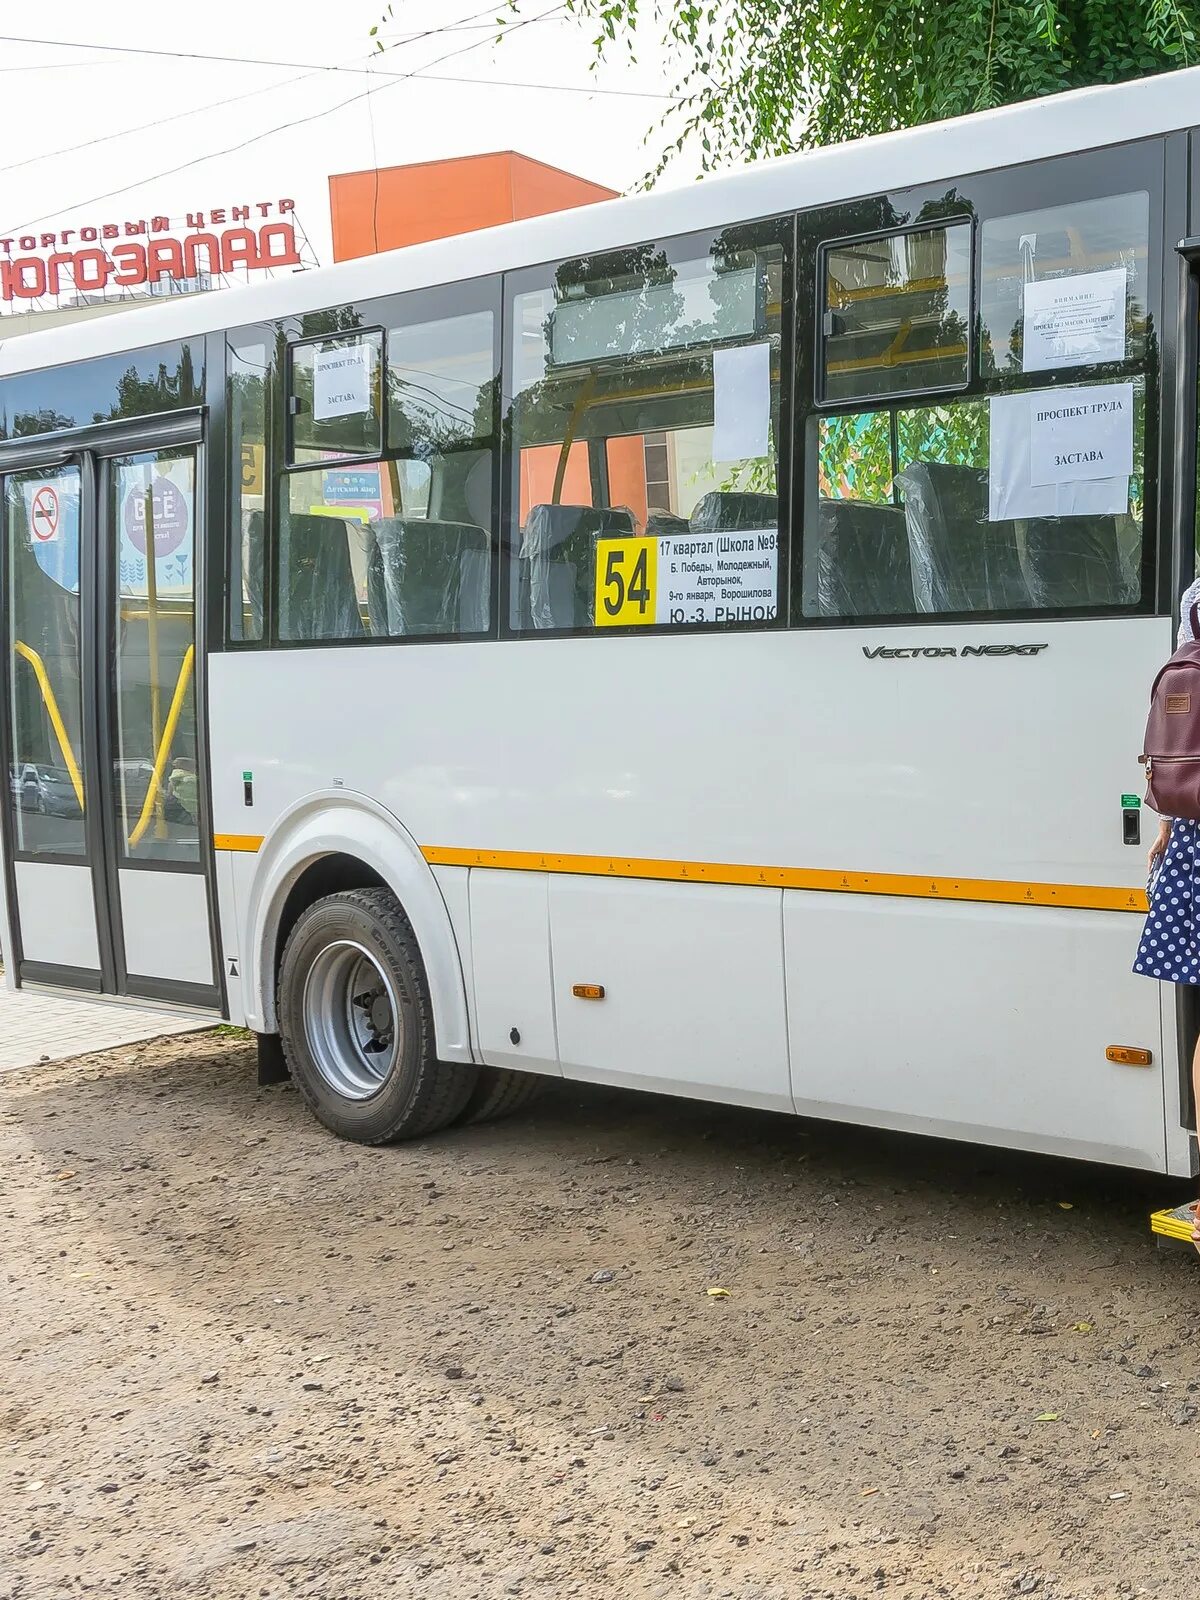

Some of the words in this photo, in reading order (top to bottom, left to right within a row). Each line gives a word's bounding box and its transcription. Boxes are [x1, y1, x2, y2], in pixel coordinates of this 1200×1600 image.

[0, 216, 170, 253] ТОРГОВЫЙ
[186, 199, 296, 229] ЦЕНТР
[0, 223, 301, 301] ЮГО-ЗАПАД
[327, 393, 356, 405] ЗАСТАВА
[1037, 404, 1089, 422] ПРОСПЕКТ
[1090, 401, 1123, 416] ТРУДА
[1054, 450, 1104, 467] ЗАСТАВА
[134, 490, 175, 521] ВСЁ
[659, 541, 671, 556] 17
[673, 540, 713, 558] квартал
[716, 537, 754, 557] (Школа
[670, 562, 679, 573] Б.
[681, 561, 714, 574] Победы,
[717, 558, 772, 572] Молодежный,
[603, 548, 650, 616] 54
[696, 573, 743, 586] Авторынок,
[669, 591, 684, 601] 9-го
[686, 590, 716, 602] января,
[721, 587, 772, 600] Ворошилова
[714, 604, 777, 622] РЫНОК
[961, 643, 1049, 657] NEXT
